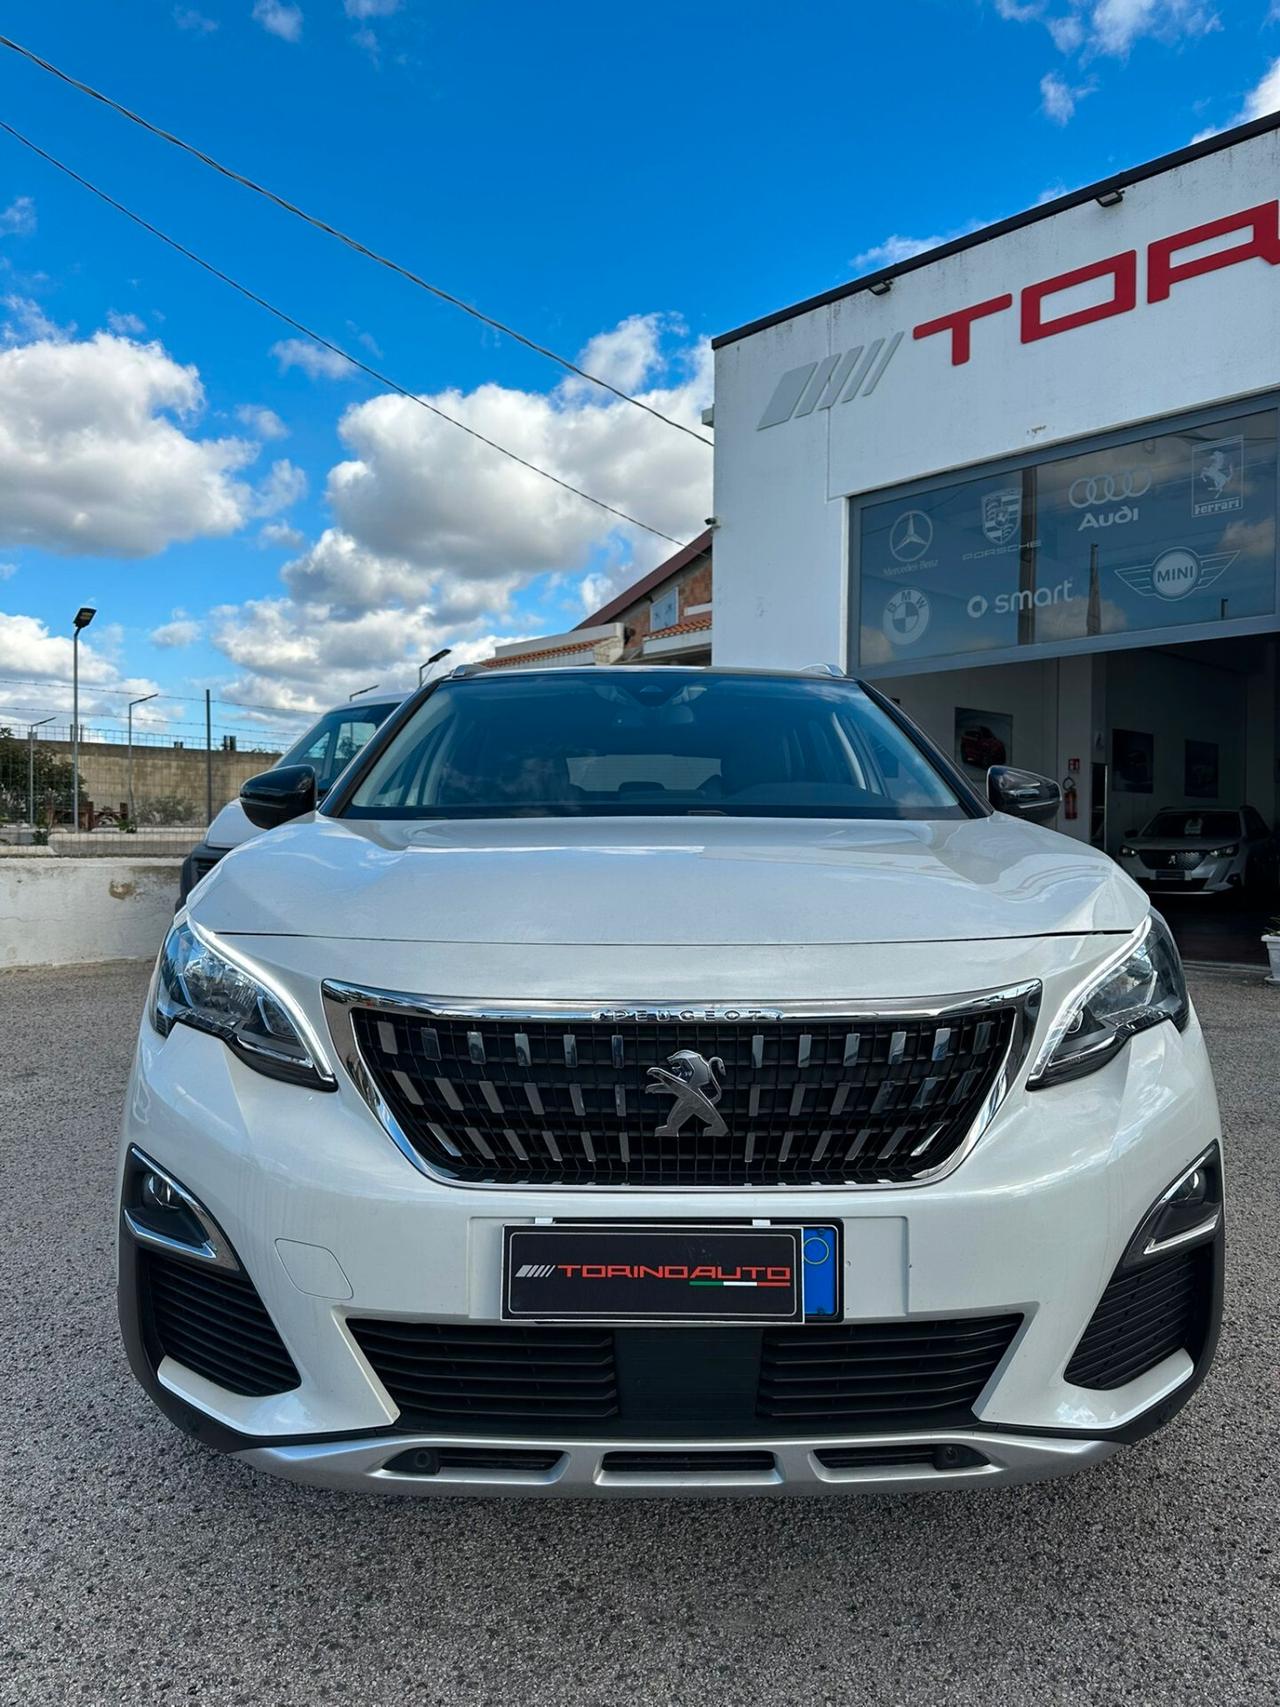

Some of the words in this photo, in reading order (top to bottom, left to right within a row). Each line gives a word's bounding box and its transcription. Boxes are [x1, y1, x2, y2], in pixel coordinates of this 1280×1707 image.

[1194, 498, 1240, 515] Ferrari
[1077, 506, 1139, 532] Audi
[962, 538, 1042, 561] PORSCHE
[1156, 565, 1195, 583] MINI
[994, 578, 1074, 614] smart
[612, 1009, 763, 1022] PEUGEOT
